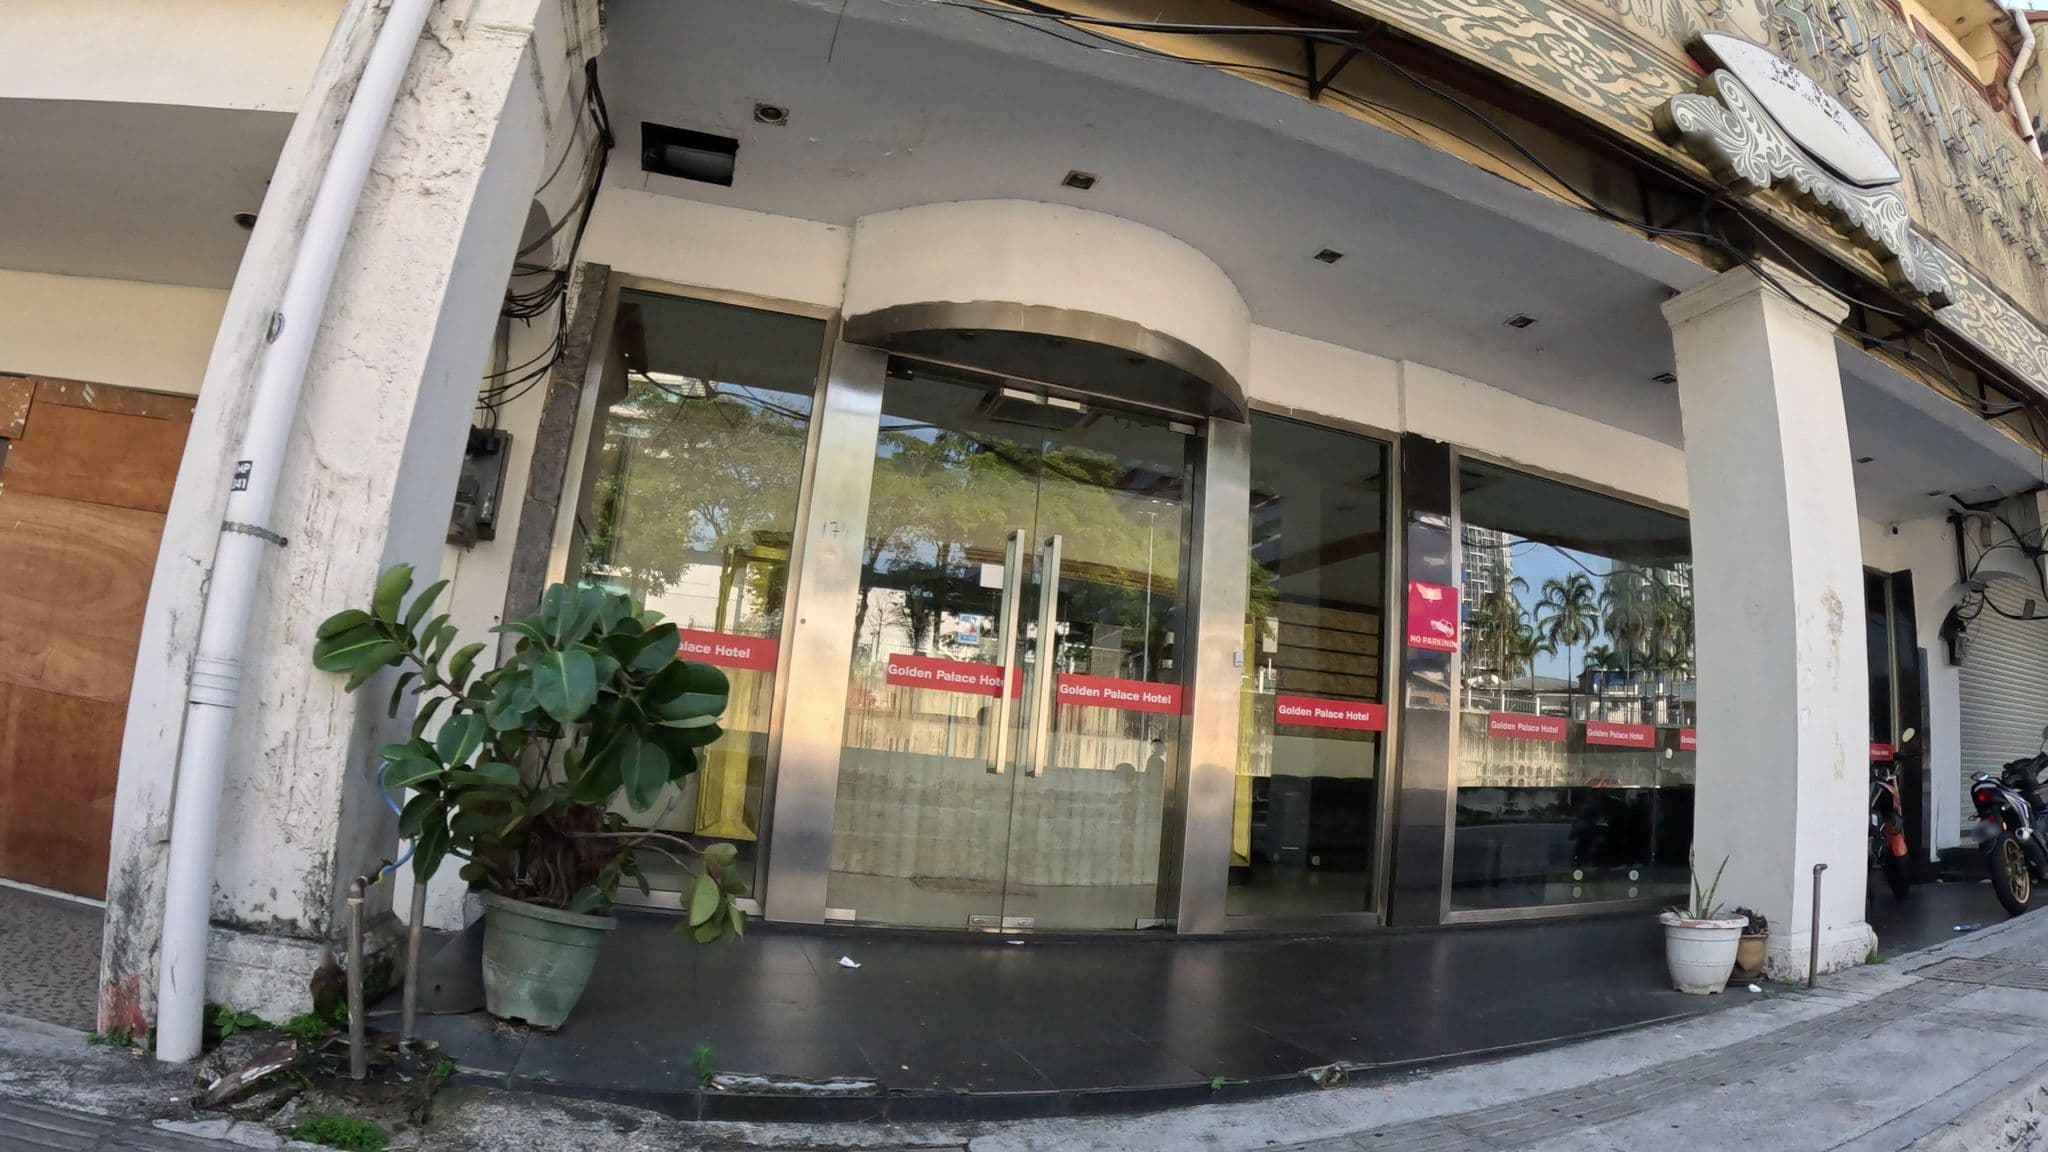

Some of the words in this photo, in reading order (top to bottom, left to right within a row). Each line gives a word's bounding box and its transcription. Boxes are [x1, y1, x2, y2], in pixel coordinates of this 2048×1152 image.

[1410, 635, 1421, 643] NO
[678, 641, 711, 654] alace
[715, 645, 751, 659] Hotel
[888, 664, 932, 679] Golden
[936, 670, 977, 684] Palace
[979, 675, 1005, 687] Hot
[1060, 684, 1100, 697] Golden
[1103, 688, 1140, 701] Palace
[1142, 692, 1172, 705] Hotel
[1278, 705, 1312, 716] Golden
[1314, 708, 1344, 719] Palace
[1346, 711, 1369, 721] Hotel
[1491, 720, 1516, 730] Golden
[1517, 723, 1540, 732] Palace
[1541, 725, 1559, 734] Hotel
[1587, 728, 1609, 737] Golden
[1609, 731, 1629, 739] Palace
[1629, 733, 1645, 741] Hotel
